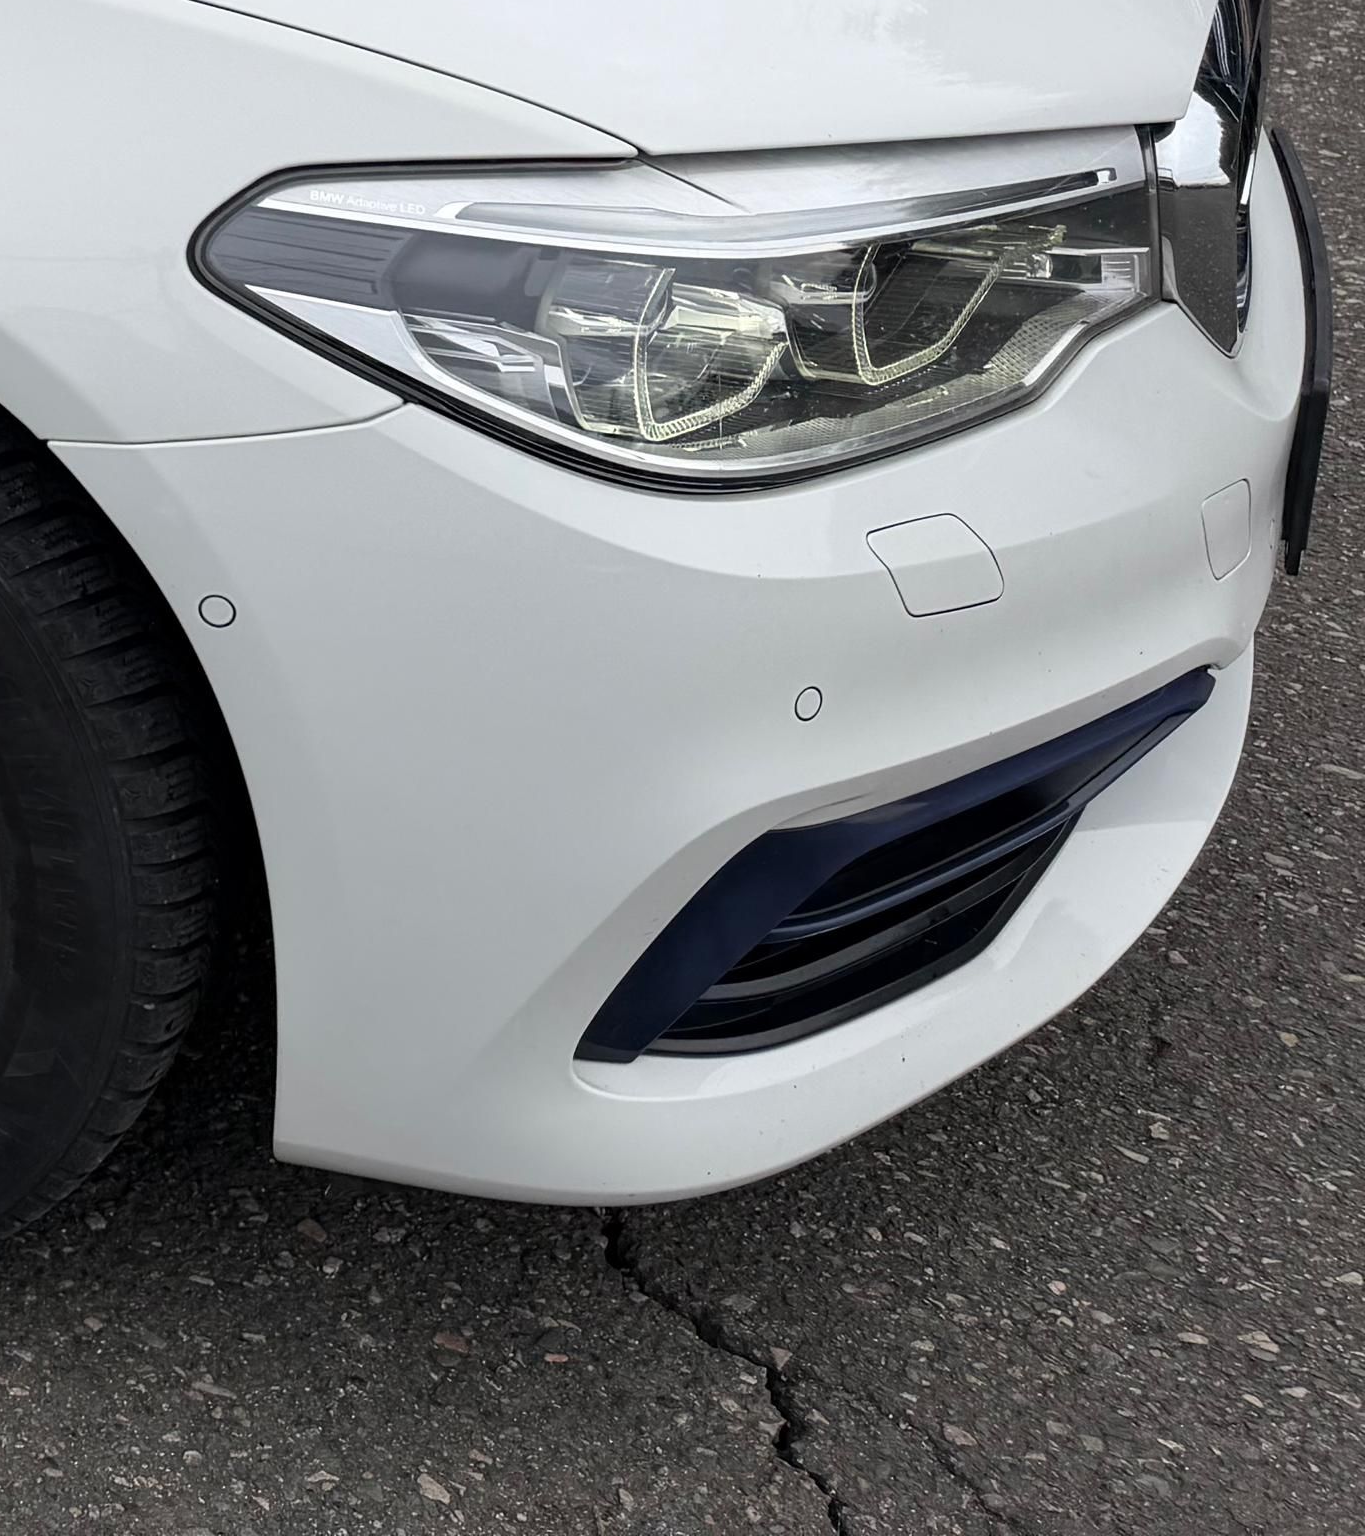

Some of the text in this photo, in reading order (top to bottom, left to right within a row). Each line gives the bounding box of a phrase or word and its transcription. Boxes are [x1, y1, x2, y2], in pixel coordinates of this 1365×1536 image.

[310, 190, 425, 215] BMW Adaptive LED
